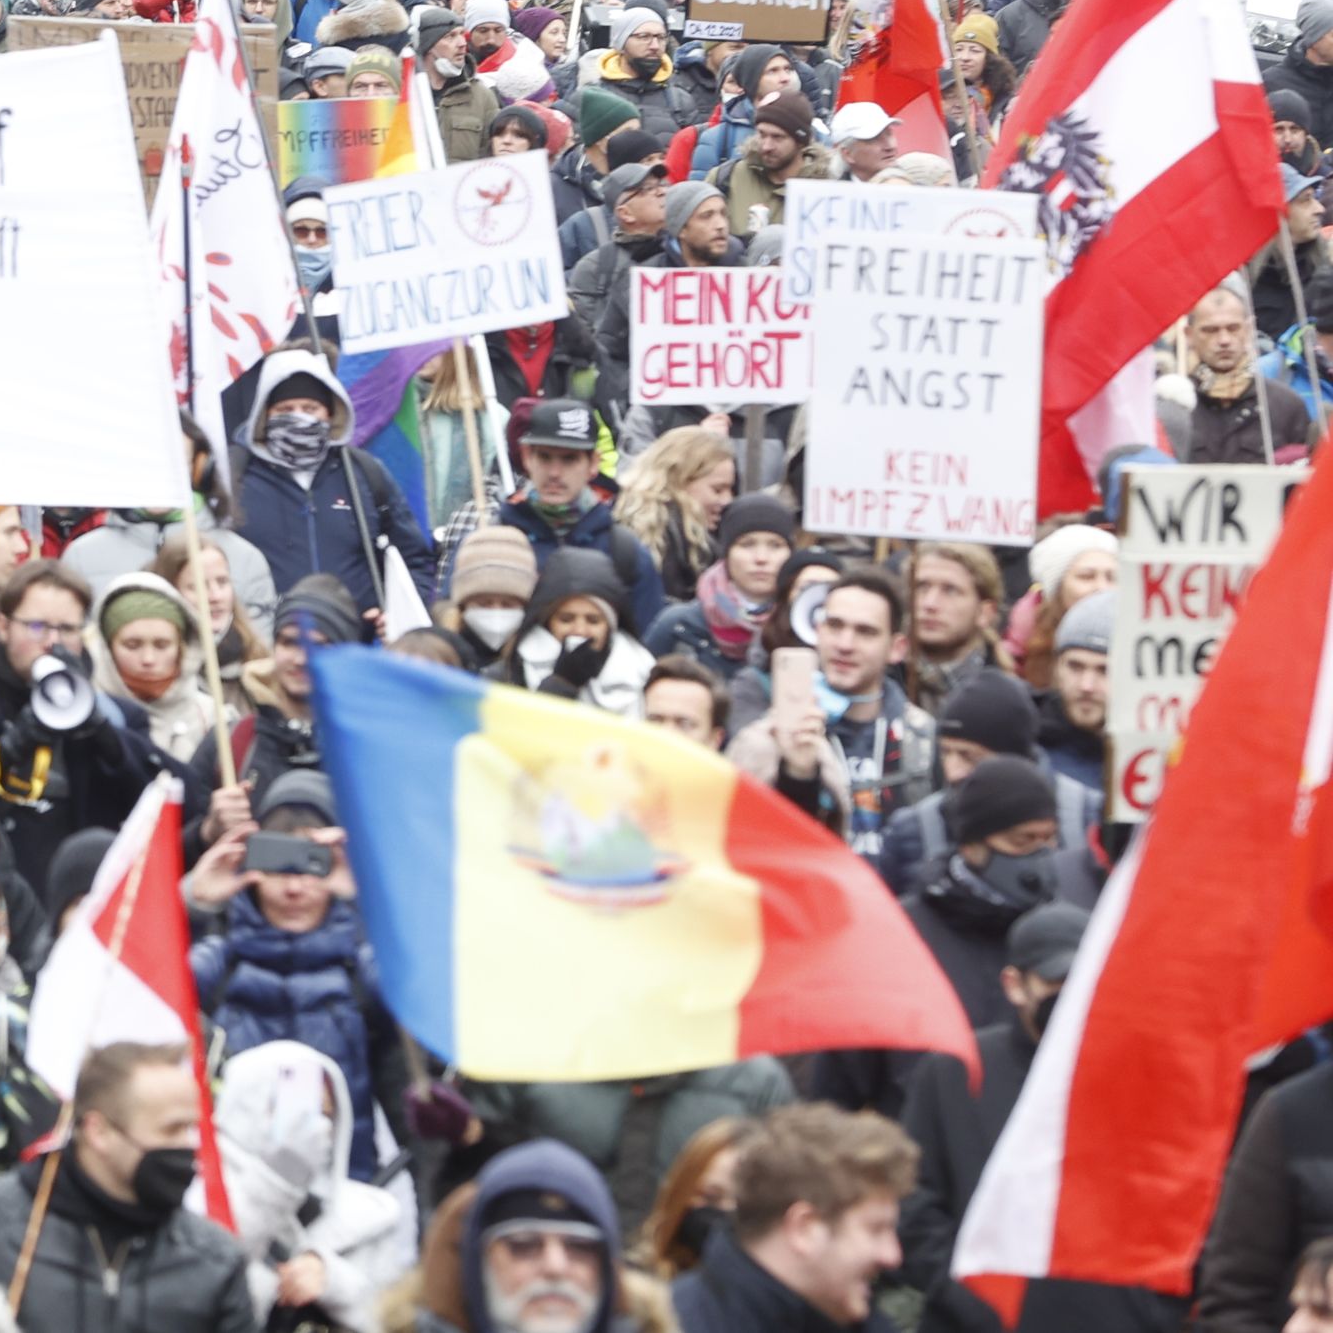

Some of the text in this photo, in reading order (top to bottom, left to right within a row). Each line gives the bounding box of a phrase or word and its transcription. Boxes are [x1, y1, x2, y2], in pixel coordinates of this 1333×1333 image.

[327, 189, 434, 263] FREIER
[639, 270, 732, 326] MEIN
[823, 244, 1038, 305] FREIHEIT
[640, 328, 803, 399] GEHÖRT
[871, 312, 1001, 358] STATT
[842, 366, 1004, 414] ANGST
[886, 450, 970, 488] KEIN
[1136, 477, 1248, 545] WIR
